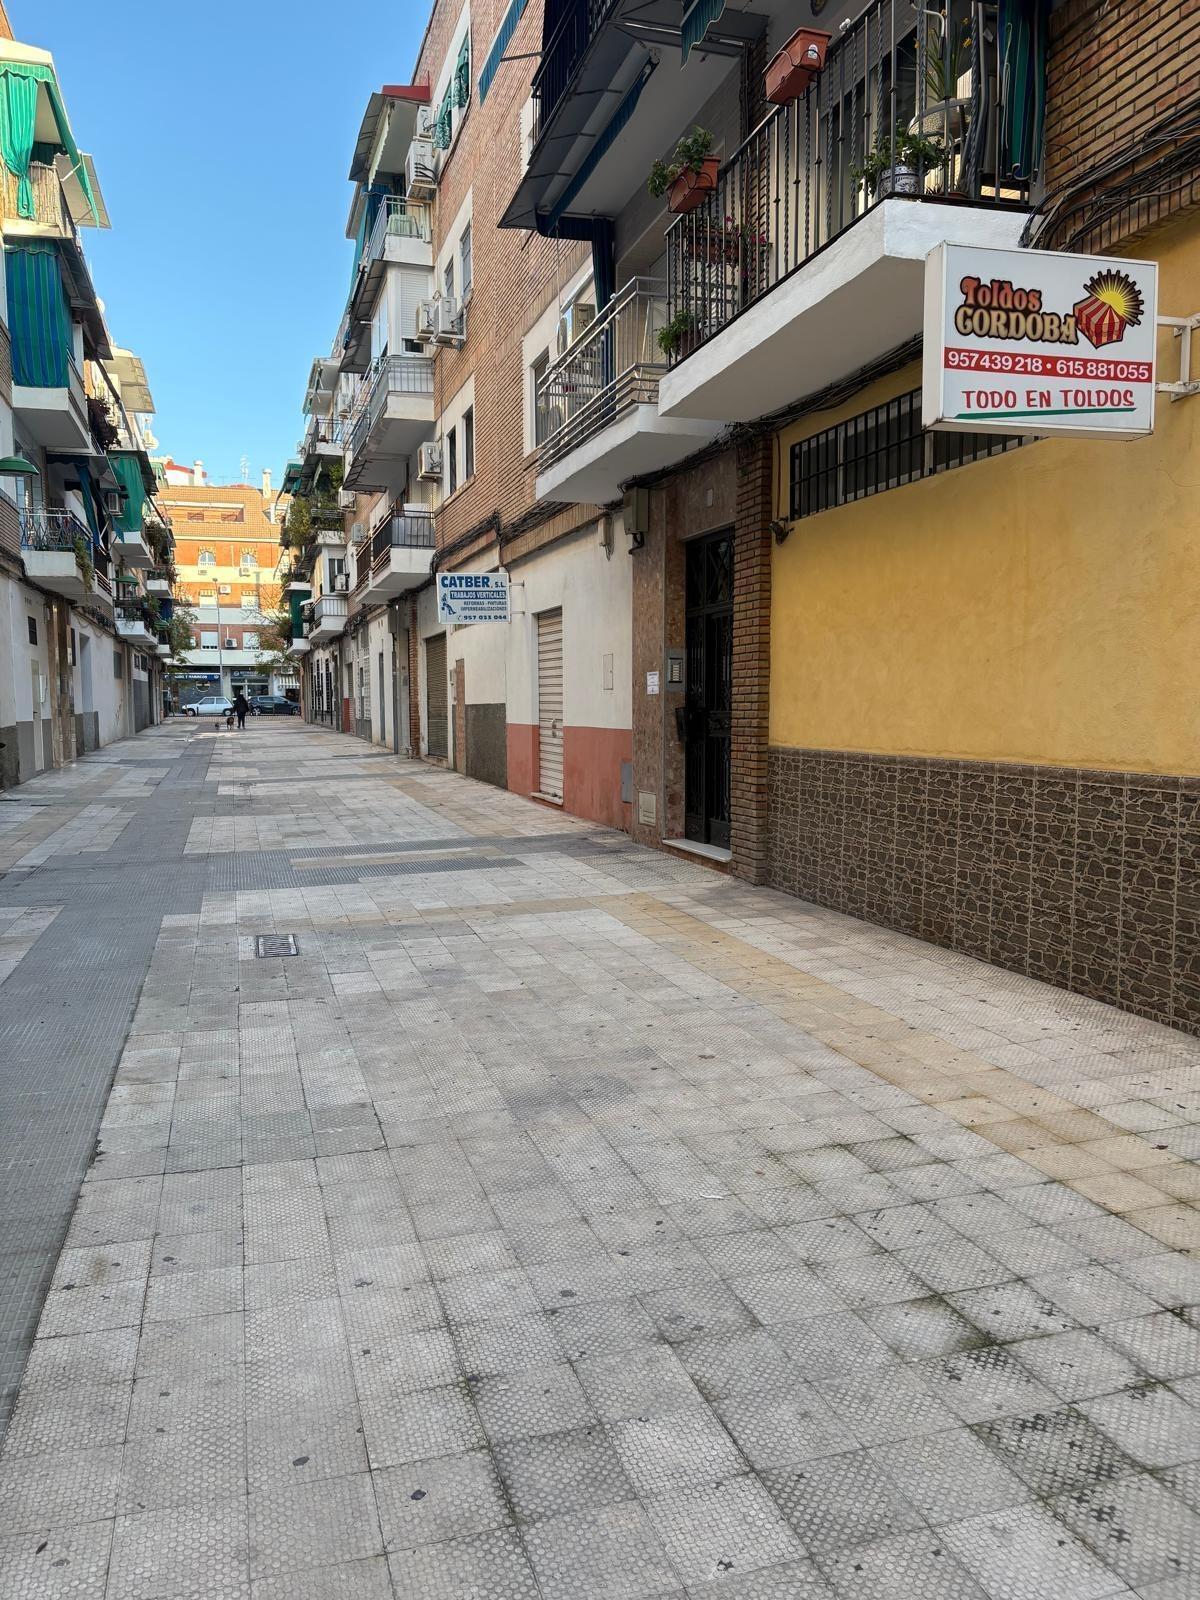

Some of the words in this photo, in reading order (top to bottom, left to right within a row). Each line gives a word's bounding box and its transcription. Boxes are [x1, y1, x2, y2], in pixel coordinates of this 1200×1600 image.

[960, 276, 1042, 312] Toldos
[961, 390, 1017, 409] TODO
[1025, 390, 1051, 408] EN
[1059, 389, 1135, 408] TOLDOS
[451, 591, 476, 599] TRABAJOS
[477, 591, 506, 599] VERTICALES
